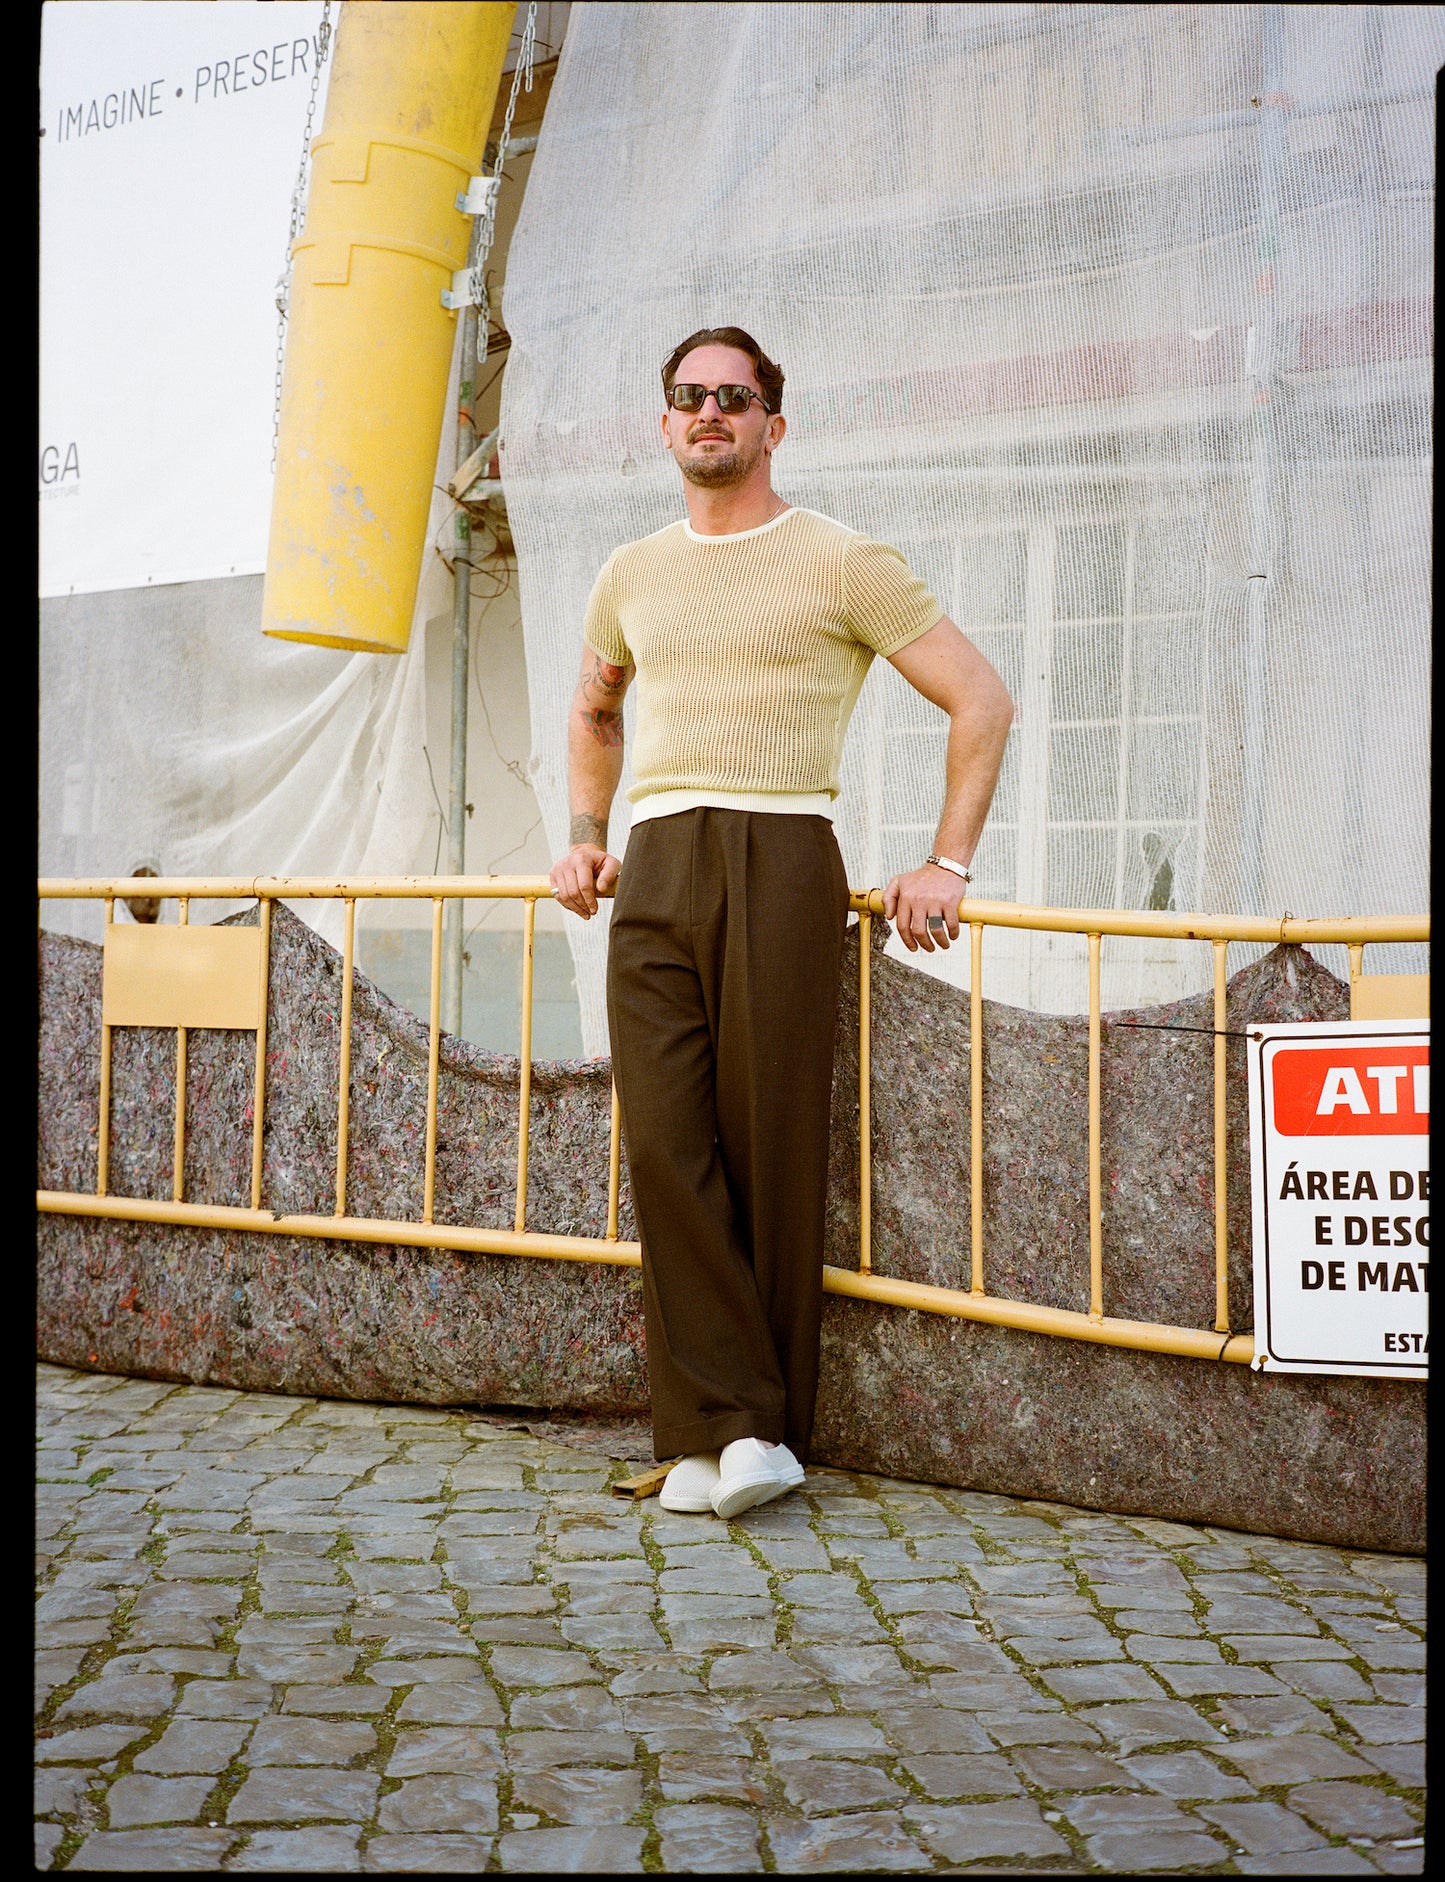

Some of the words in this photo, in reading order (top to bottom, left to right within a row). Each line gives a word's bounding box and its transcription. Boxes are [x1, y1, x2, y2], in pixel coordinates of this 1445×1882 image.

[58, 79, 165, 143] IMAGINE
[195, 29, 338, 103] PRESERV
[40, 442, 80, 484] GA
[1279, 1161, 1378, 1201] ÁREA
[1314, 1215, 1333, 1245] E
[1301, 1260, 1346, 1291] DE
